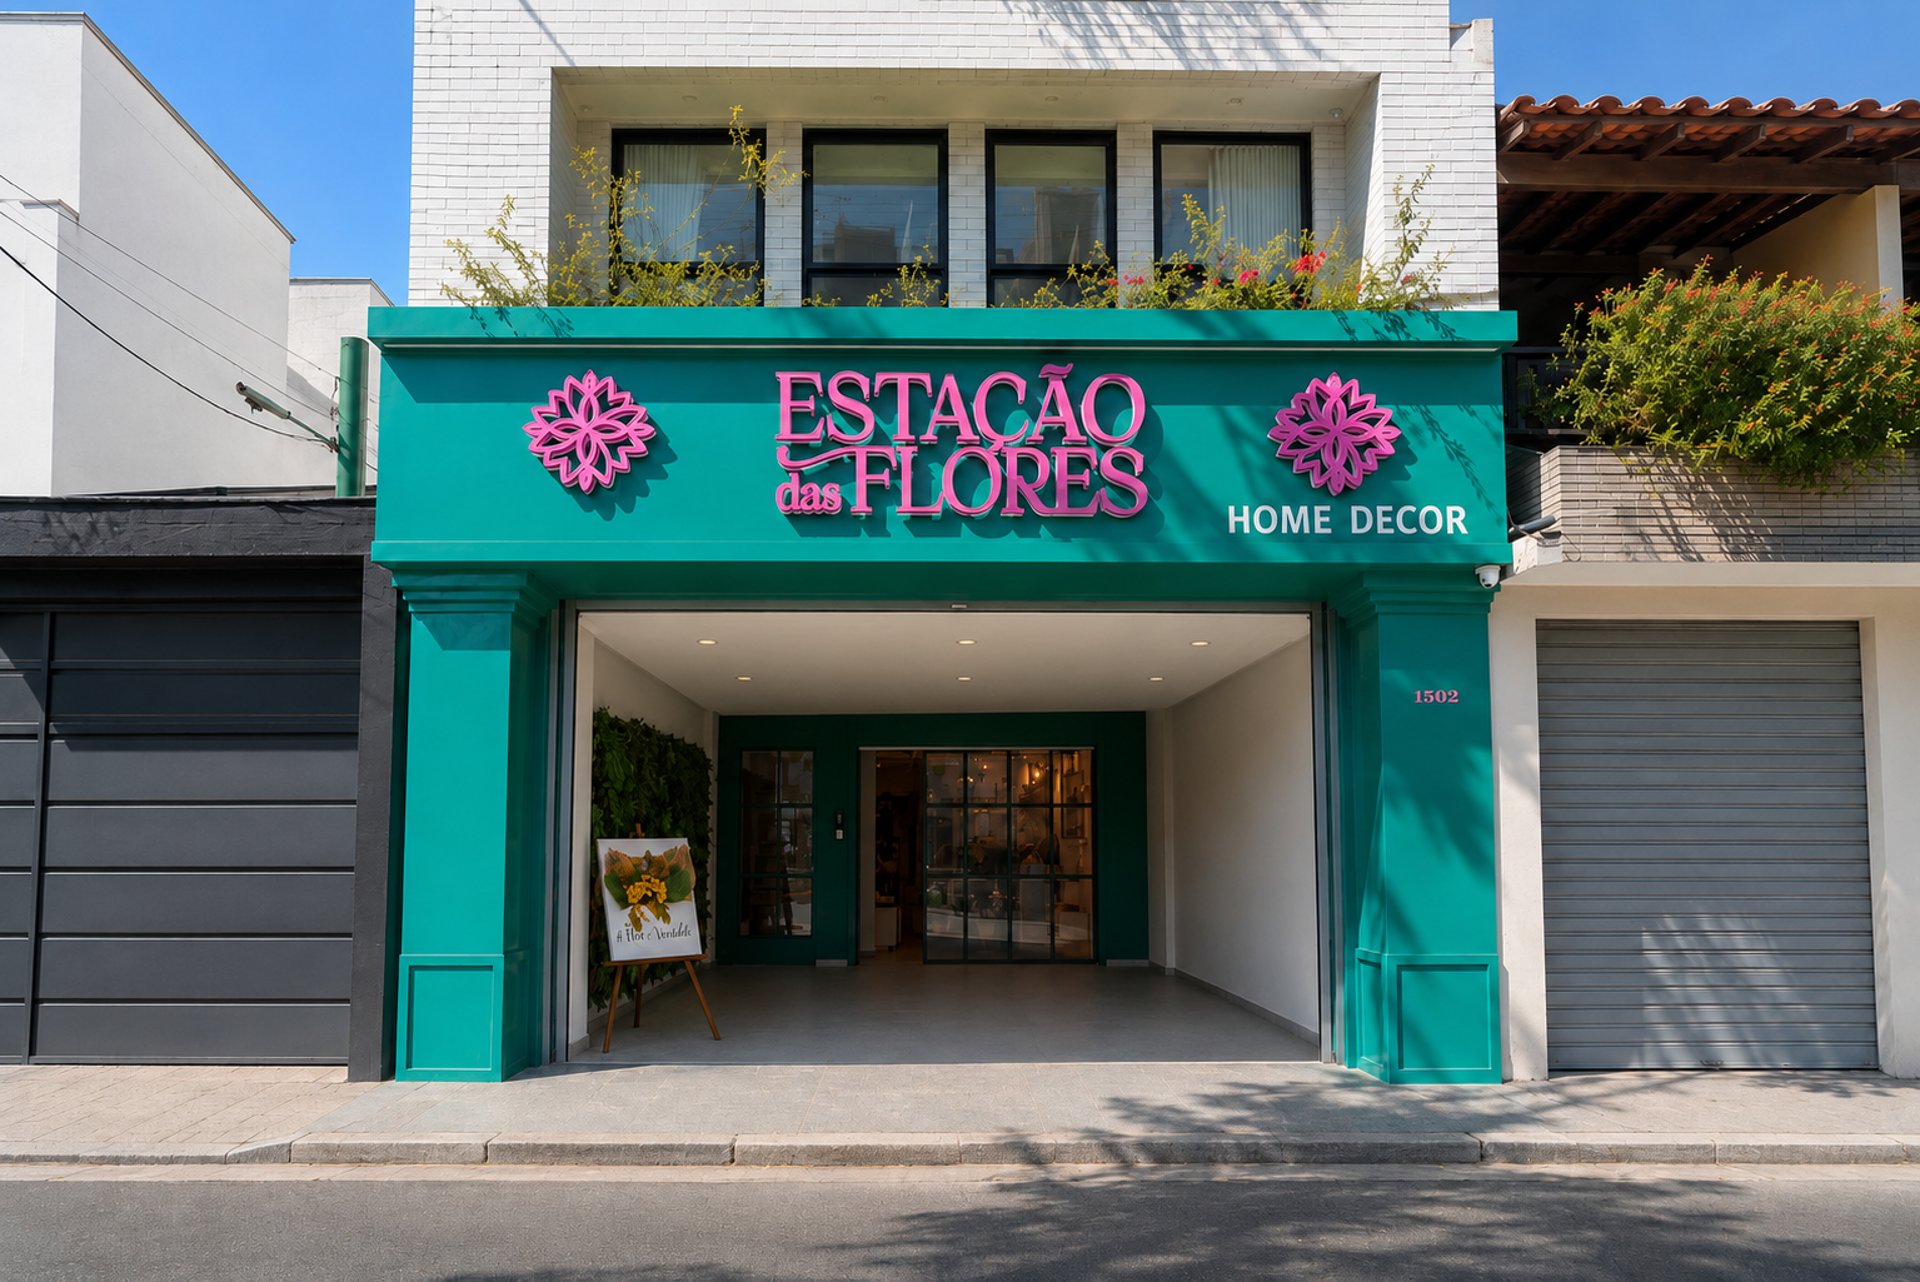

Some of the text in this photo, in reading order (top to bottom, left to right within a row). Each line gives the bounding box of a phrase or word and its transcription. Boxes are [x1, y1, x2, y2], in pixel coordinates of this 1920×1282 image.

[775, 363, 1146, 452] ESTAÇÃO
[775, 445, 1149, 519] das FLORES
[1228, 505, 1468, 534] HOME DECOR
[1414, 690, 1459, 704] 1502
